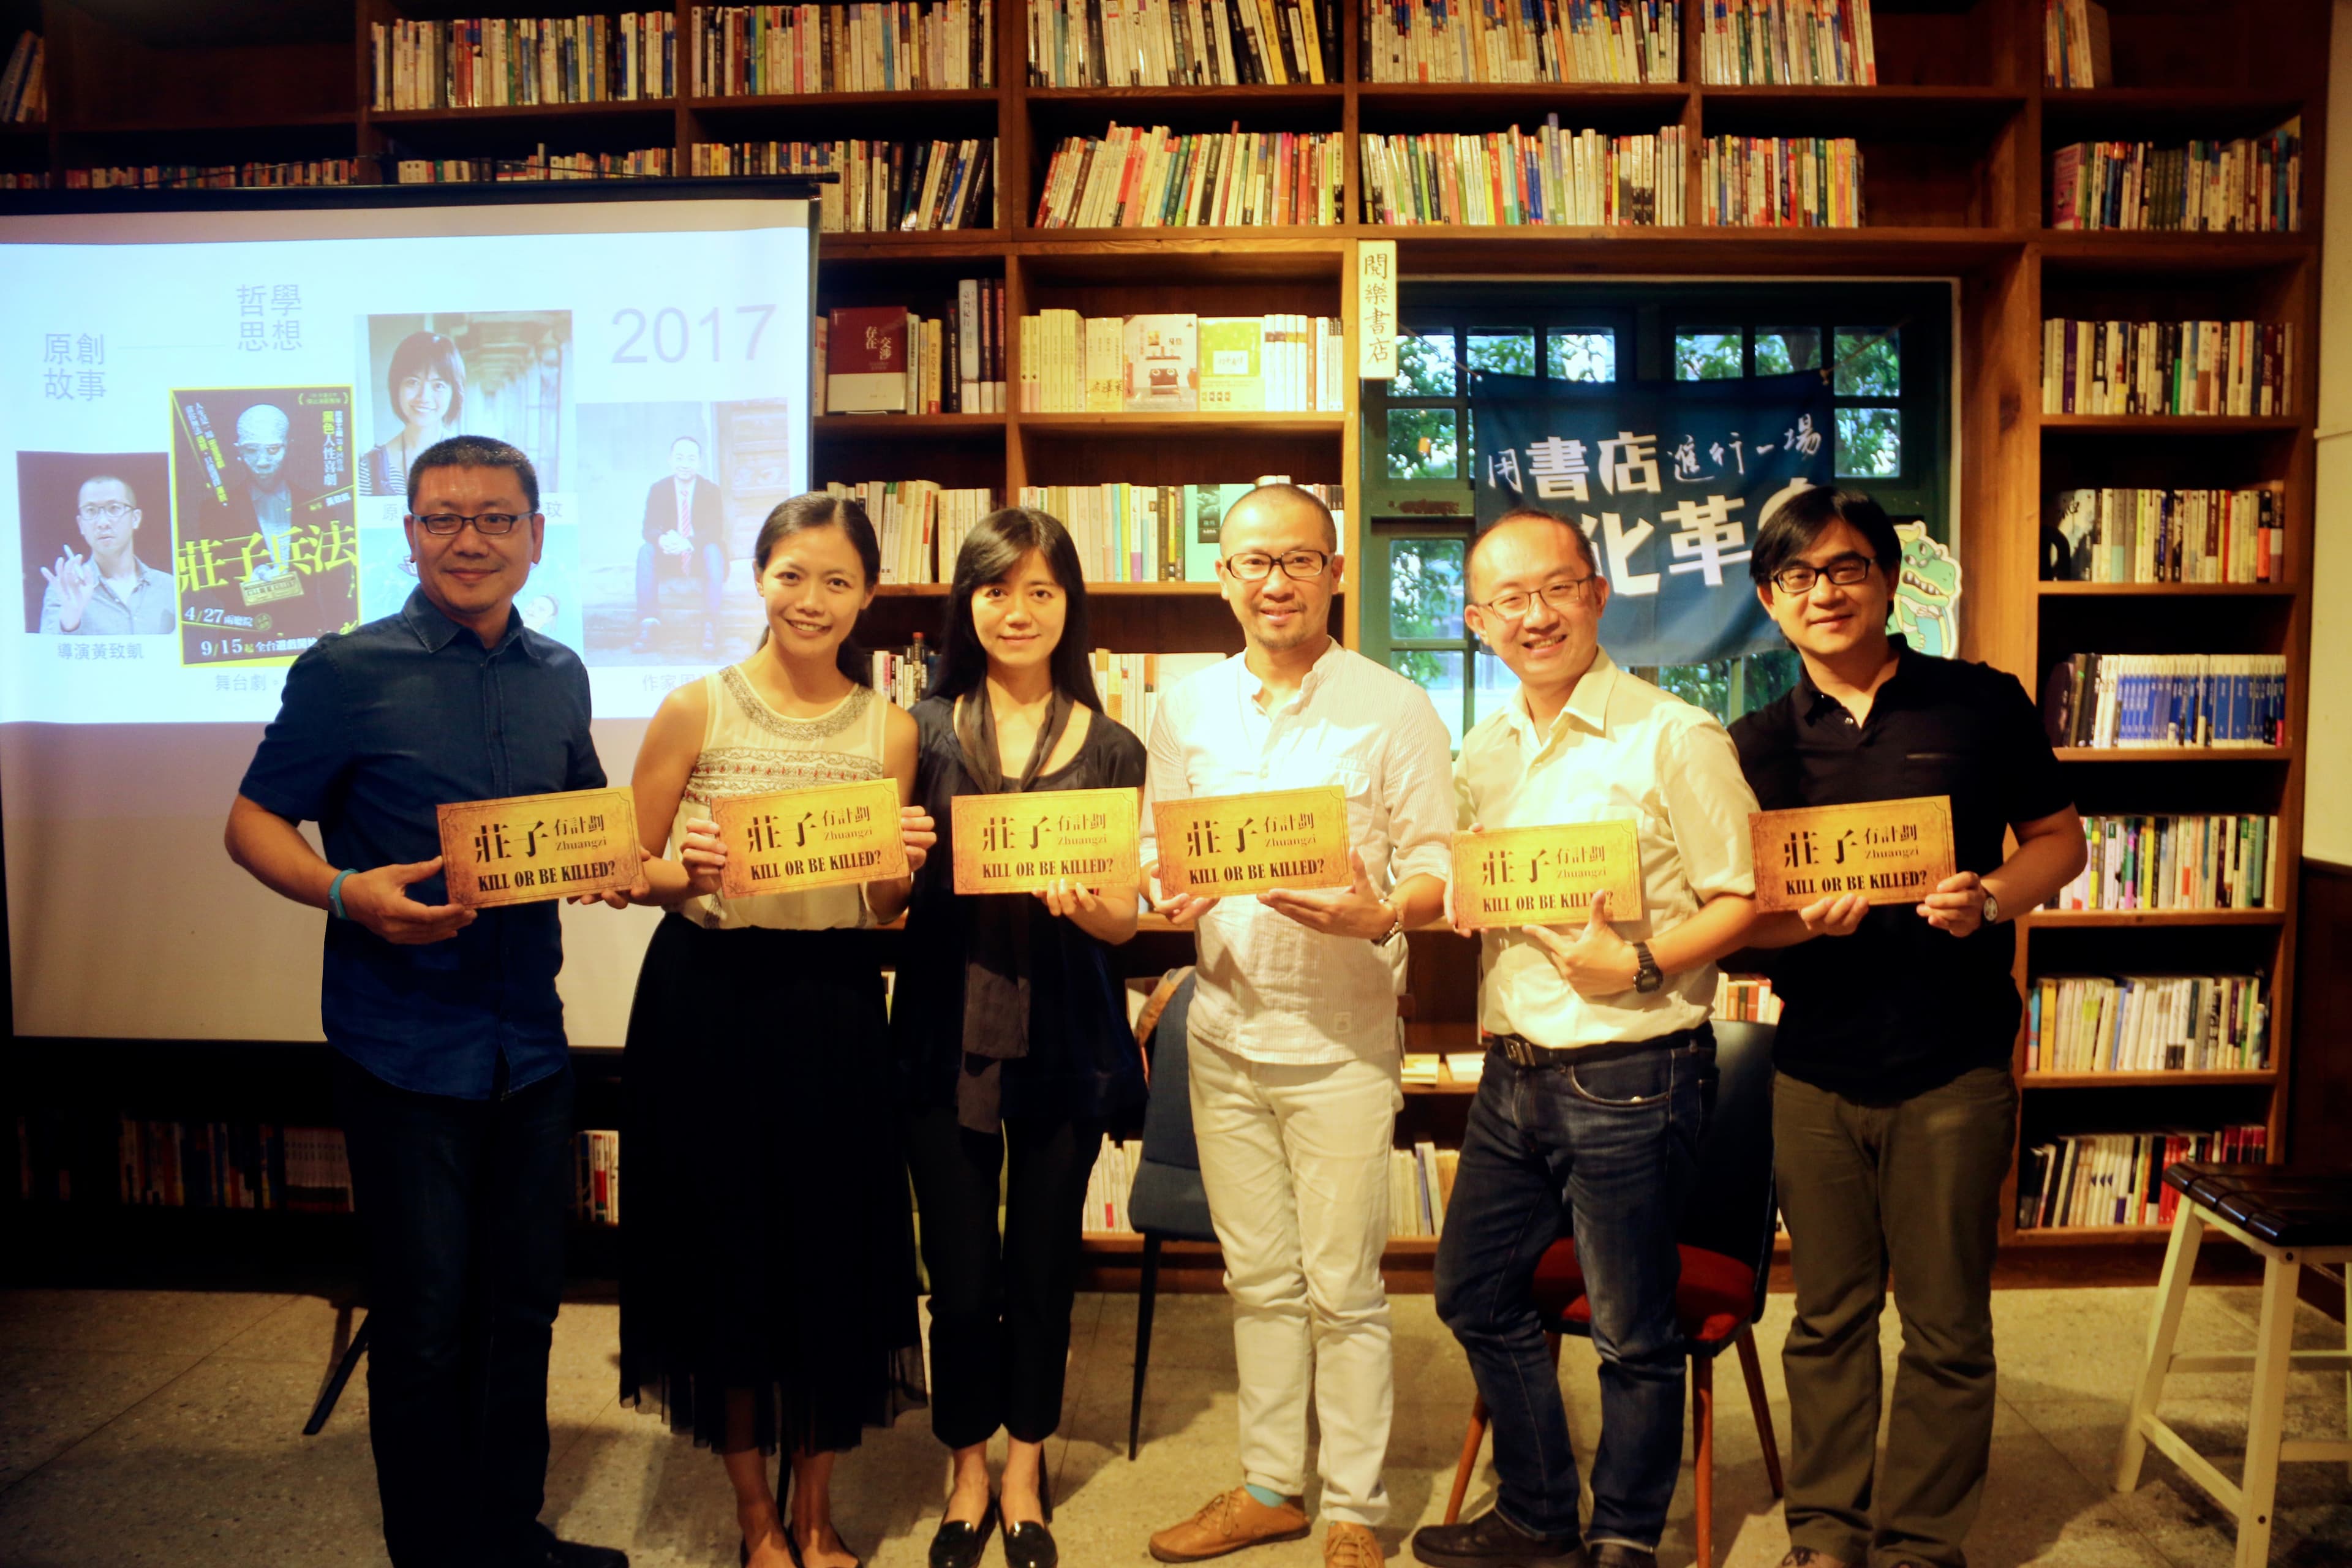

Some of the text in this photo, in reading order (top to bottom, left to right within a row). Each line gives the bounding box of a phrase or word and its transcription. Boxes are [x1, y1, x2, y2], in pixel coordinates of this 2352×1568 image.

[236, 284, 303, 317] 哲學
[1364, 253, 1391, 364] 閱樂書店
[236, 319, 303, 352] 思想
[611, 303, 777, 364] 2017
[43, 334, 106, 366] 原創
[43, 368, 107, 402] 故事
[178, 520, 358, 593] 莊子兵法
[184, 606, 224, 623] 4/27
[58, 642, 144, 660] 導演黃致凱
[475, 820, 548, 863] 莊子
[555, 836, 607, 852] Zhuangzi
[747, 812, 816, 853] 莊子
[824, 826, 873, 842] Zhuangzi
[982, 815, 1052, 851] 莊子
[1058, 833, 1107, 846] Zhuangzi
[1186, 817, 1258, 857] 莊子
[1265, 834, 1317, 848] Zhuangzi
[1784, 829, 1858, 868] 莊子
[750, 850, 881, 881] KILL OR BE KILLED?
[982, 858, 1114, 878] KILL OR BE KILLED?
[1482, 848, 1550, 886] 莊子
[1864, 845, 1920, 860] Zhuangzi
[478, 860, 616, 892] KILL OR BE KILLED?
[1189, 858, 1325, 884] KILL OR BE KILLED?
[1557, 867, 1607, 880] Zhuangzi
[1785, 869, 1928, 896] KILL OR BE KILLED?
[1483, 891, 1614, 913] KILL OR BE KILL?
